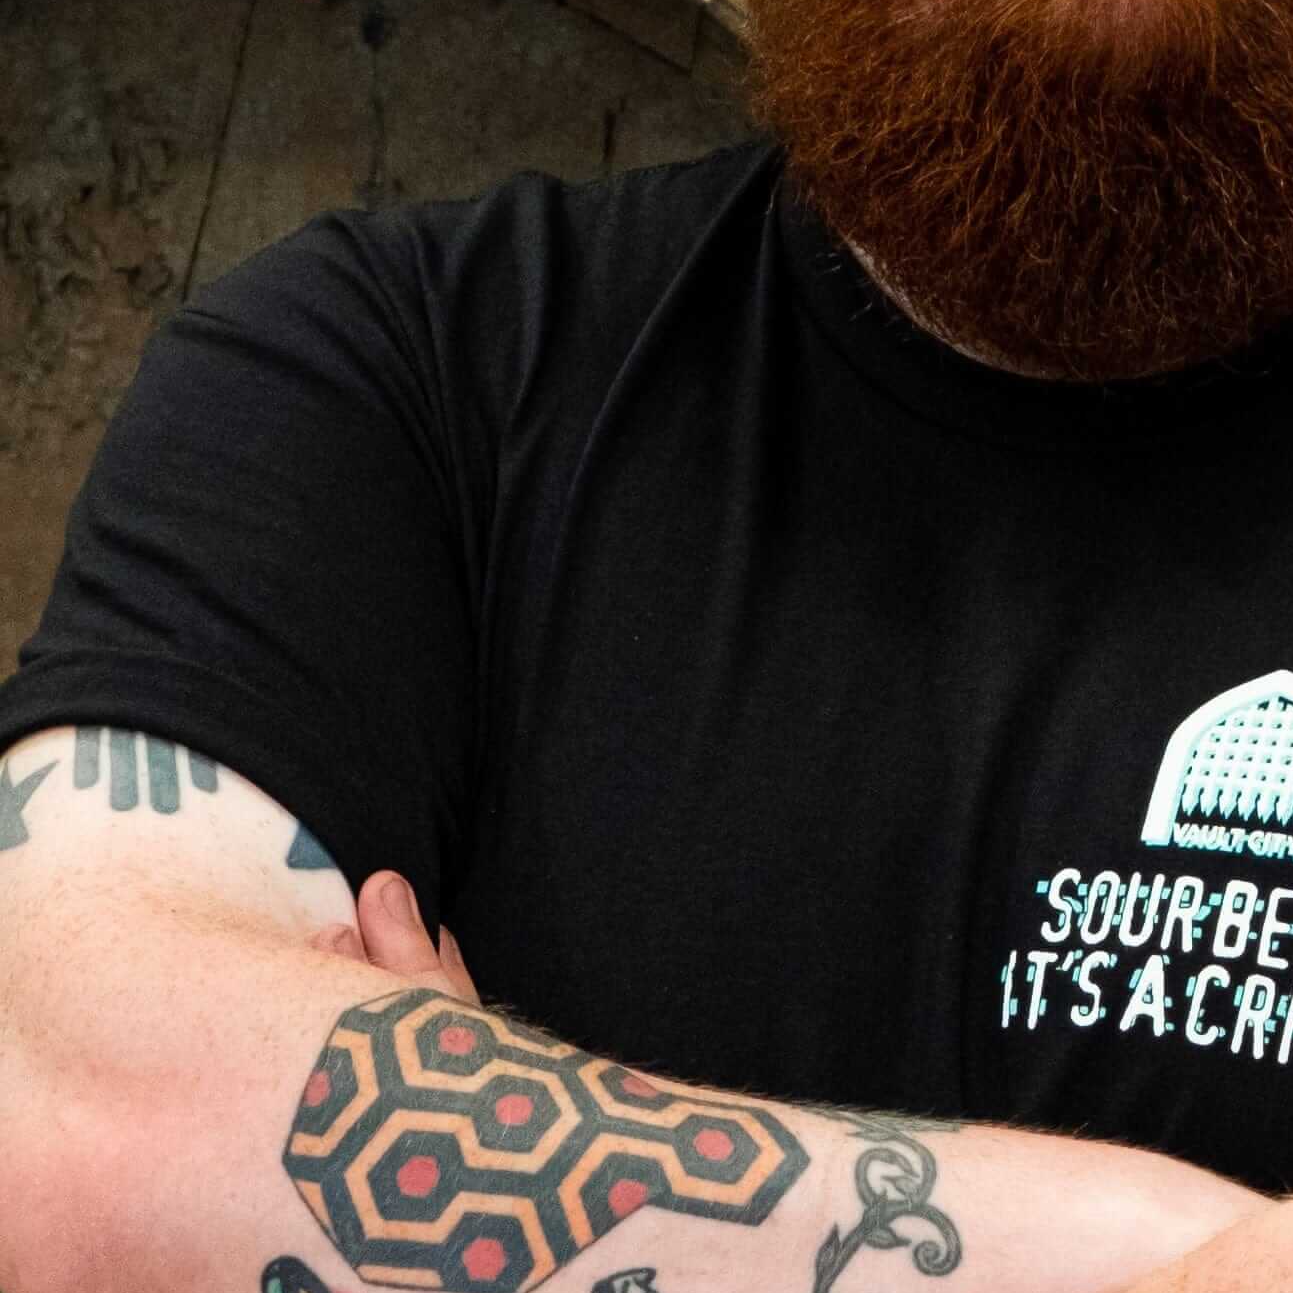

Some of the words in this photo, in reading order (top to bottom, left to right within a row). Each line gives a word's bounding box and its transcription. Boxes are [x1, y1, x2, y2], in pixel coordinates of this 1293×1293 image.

[1174, 821, 1246, 854] VAULT
[1040, 867, 1205, 953] SOUR
[1000, 948, 1109, 1030] IT'S
[1119, 953, 1166, 1038] A
